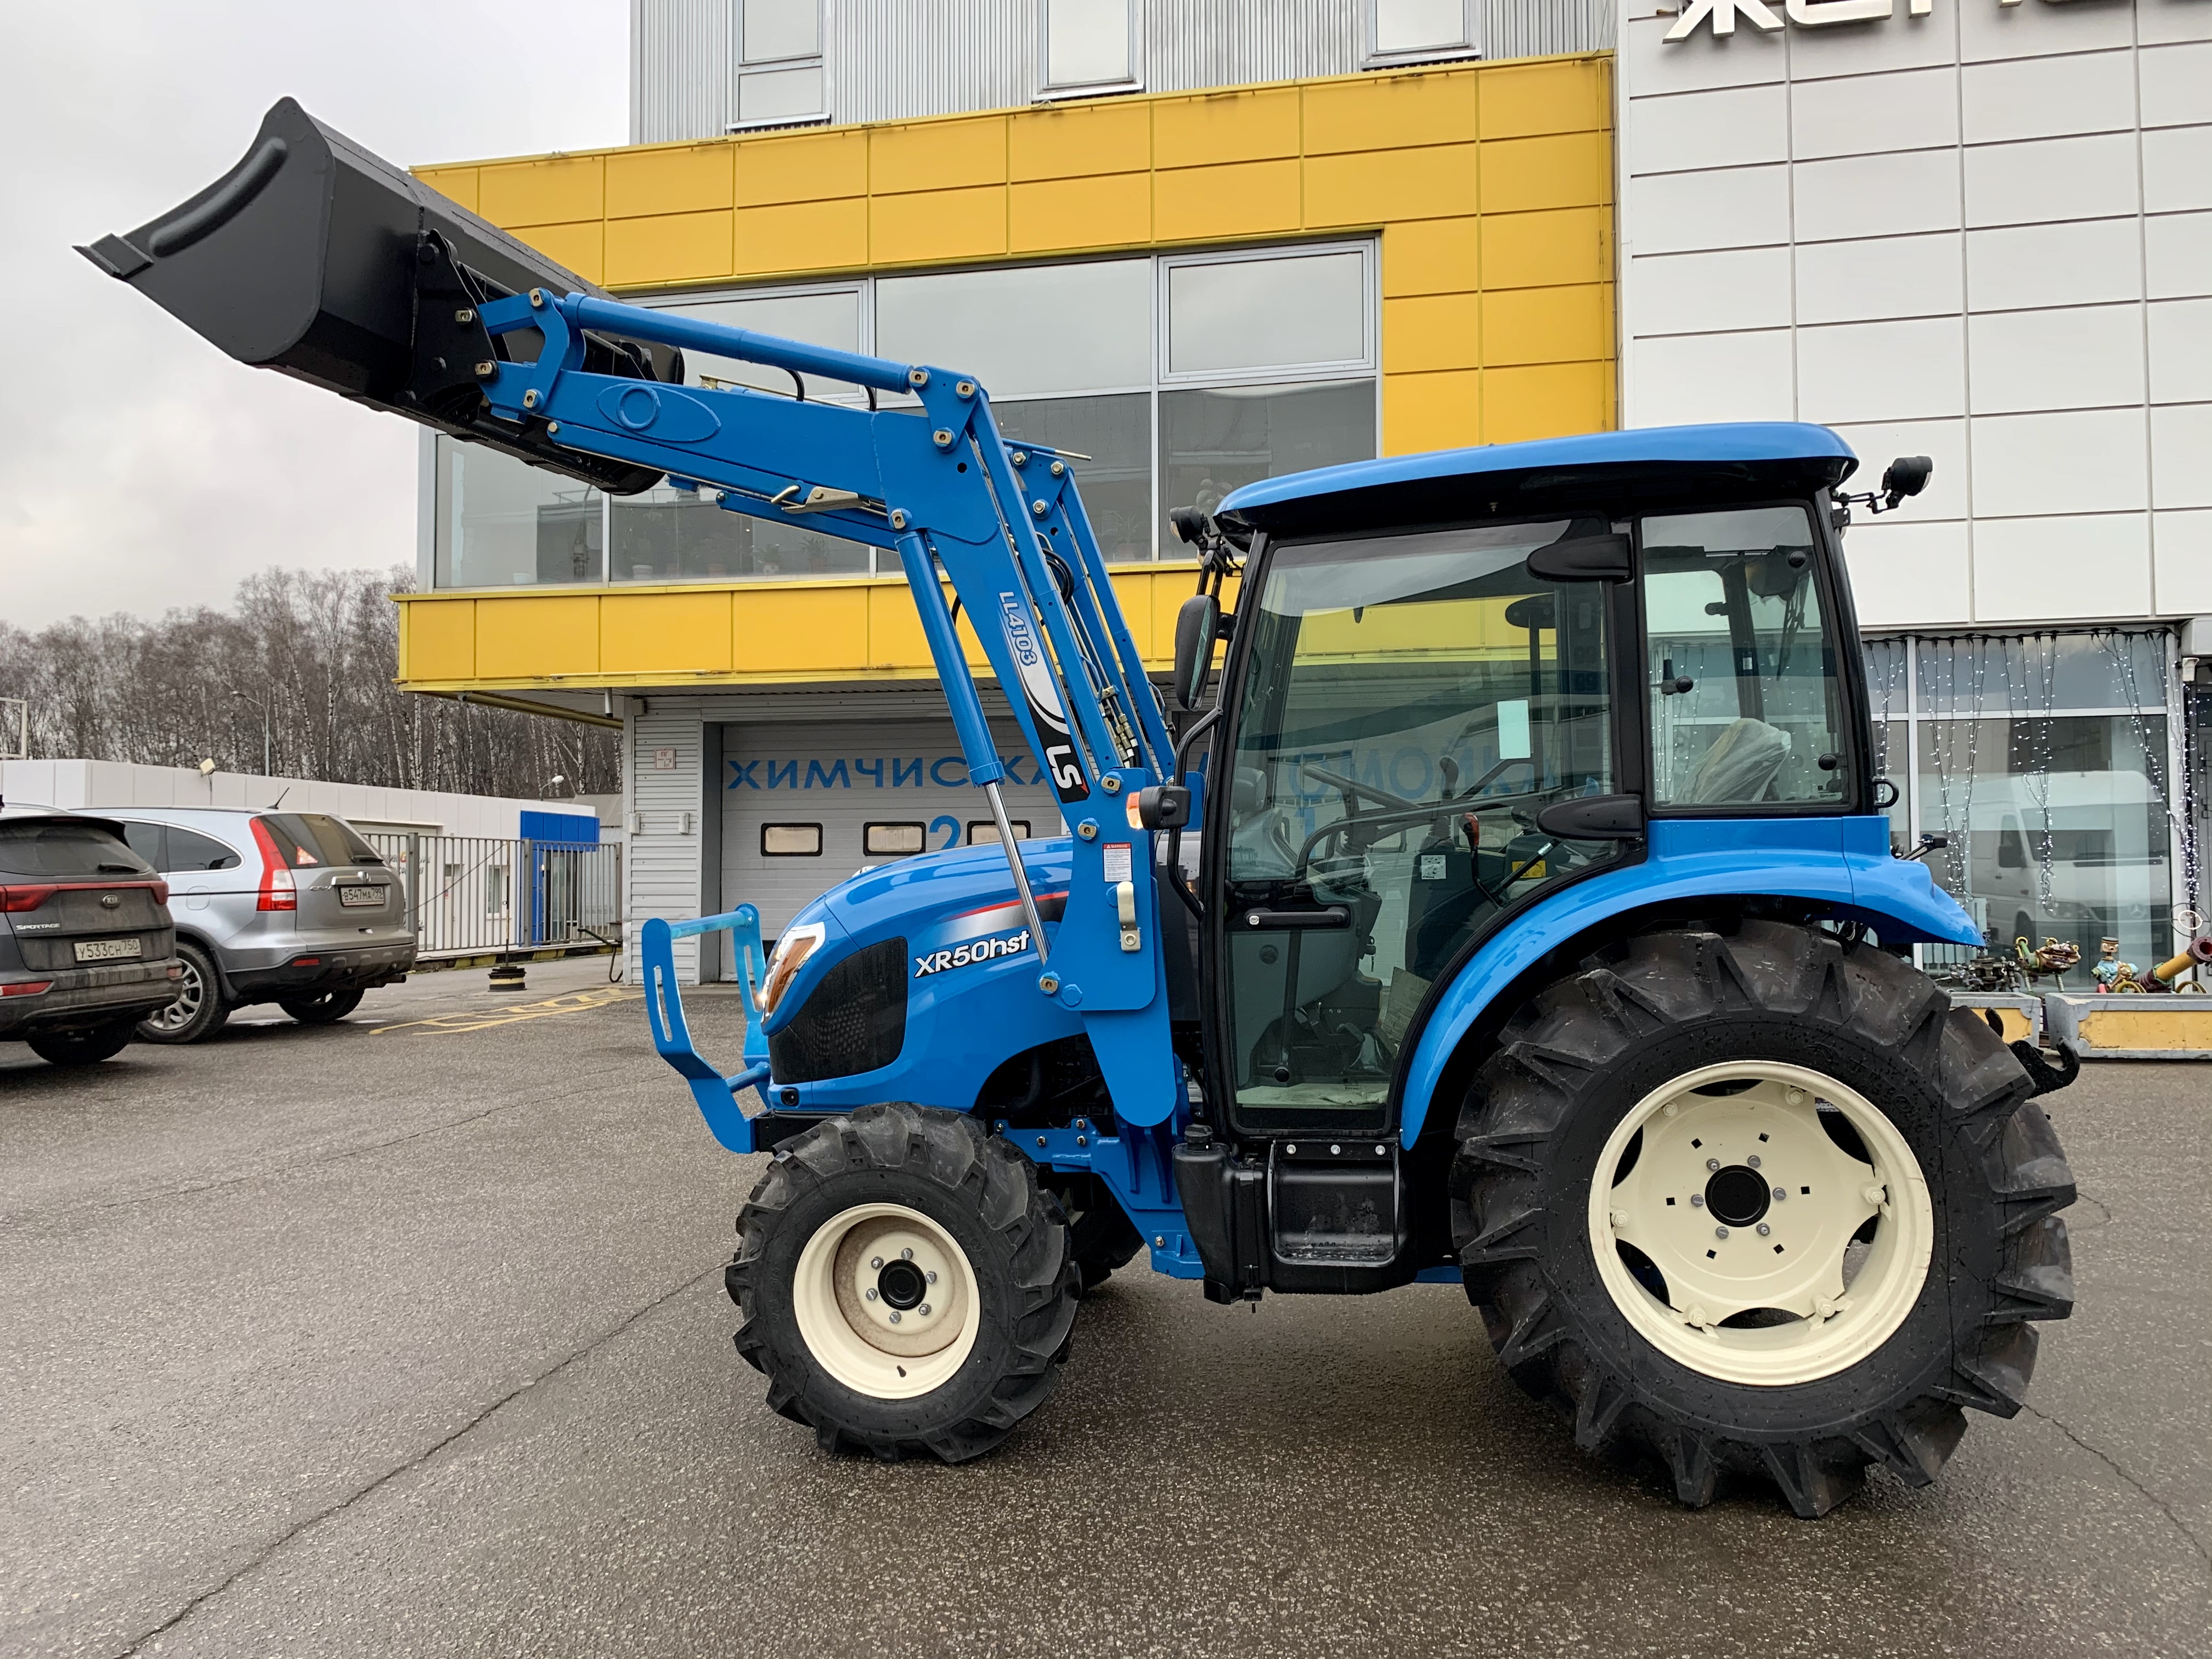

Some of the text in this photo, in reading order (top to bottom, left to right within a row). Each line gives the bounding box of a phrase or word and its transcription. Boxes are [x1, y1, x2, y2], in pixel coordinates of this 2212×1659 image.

[998, 591, 1037, 666] LL4103
[1046, 744, 1083, 789] LS
[915, 930, 1030, 978] XR50hst
